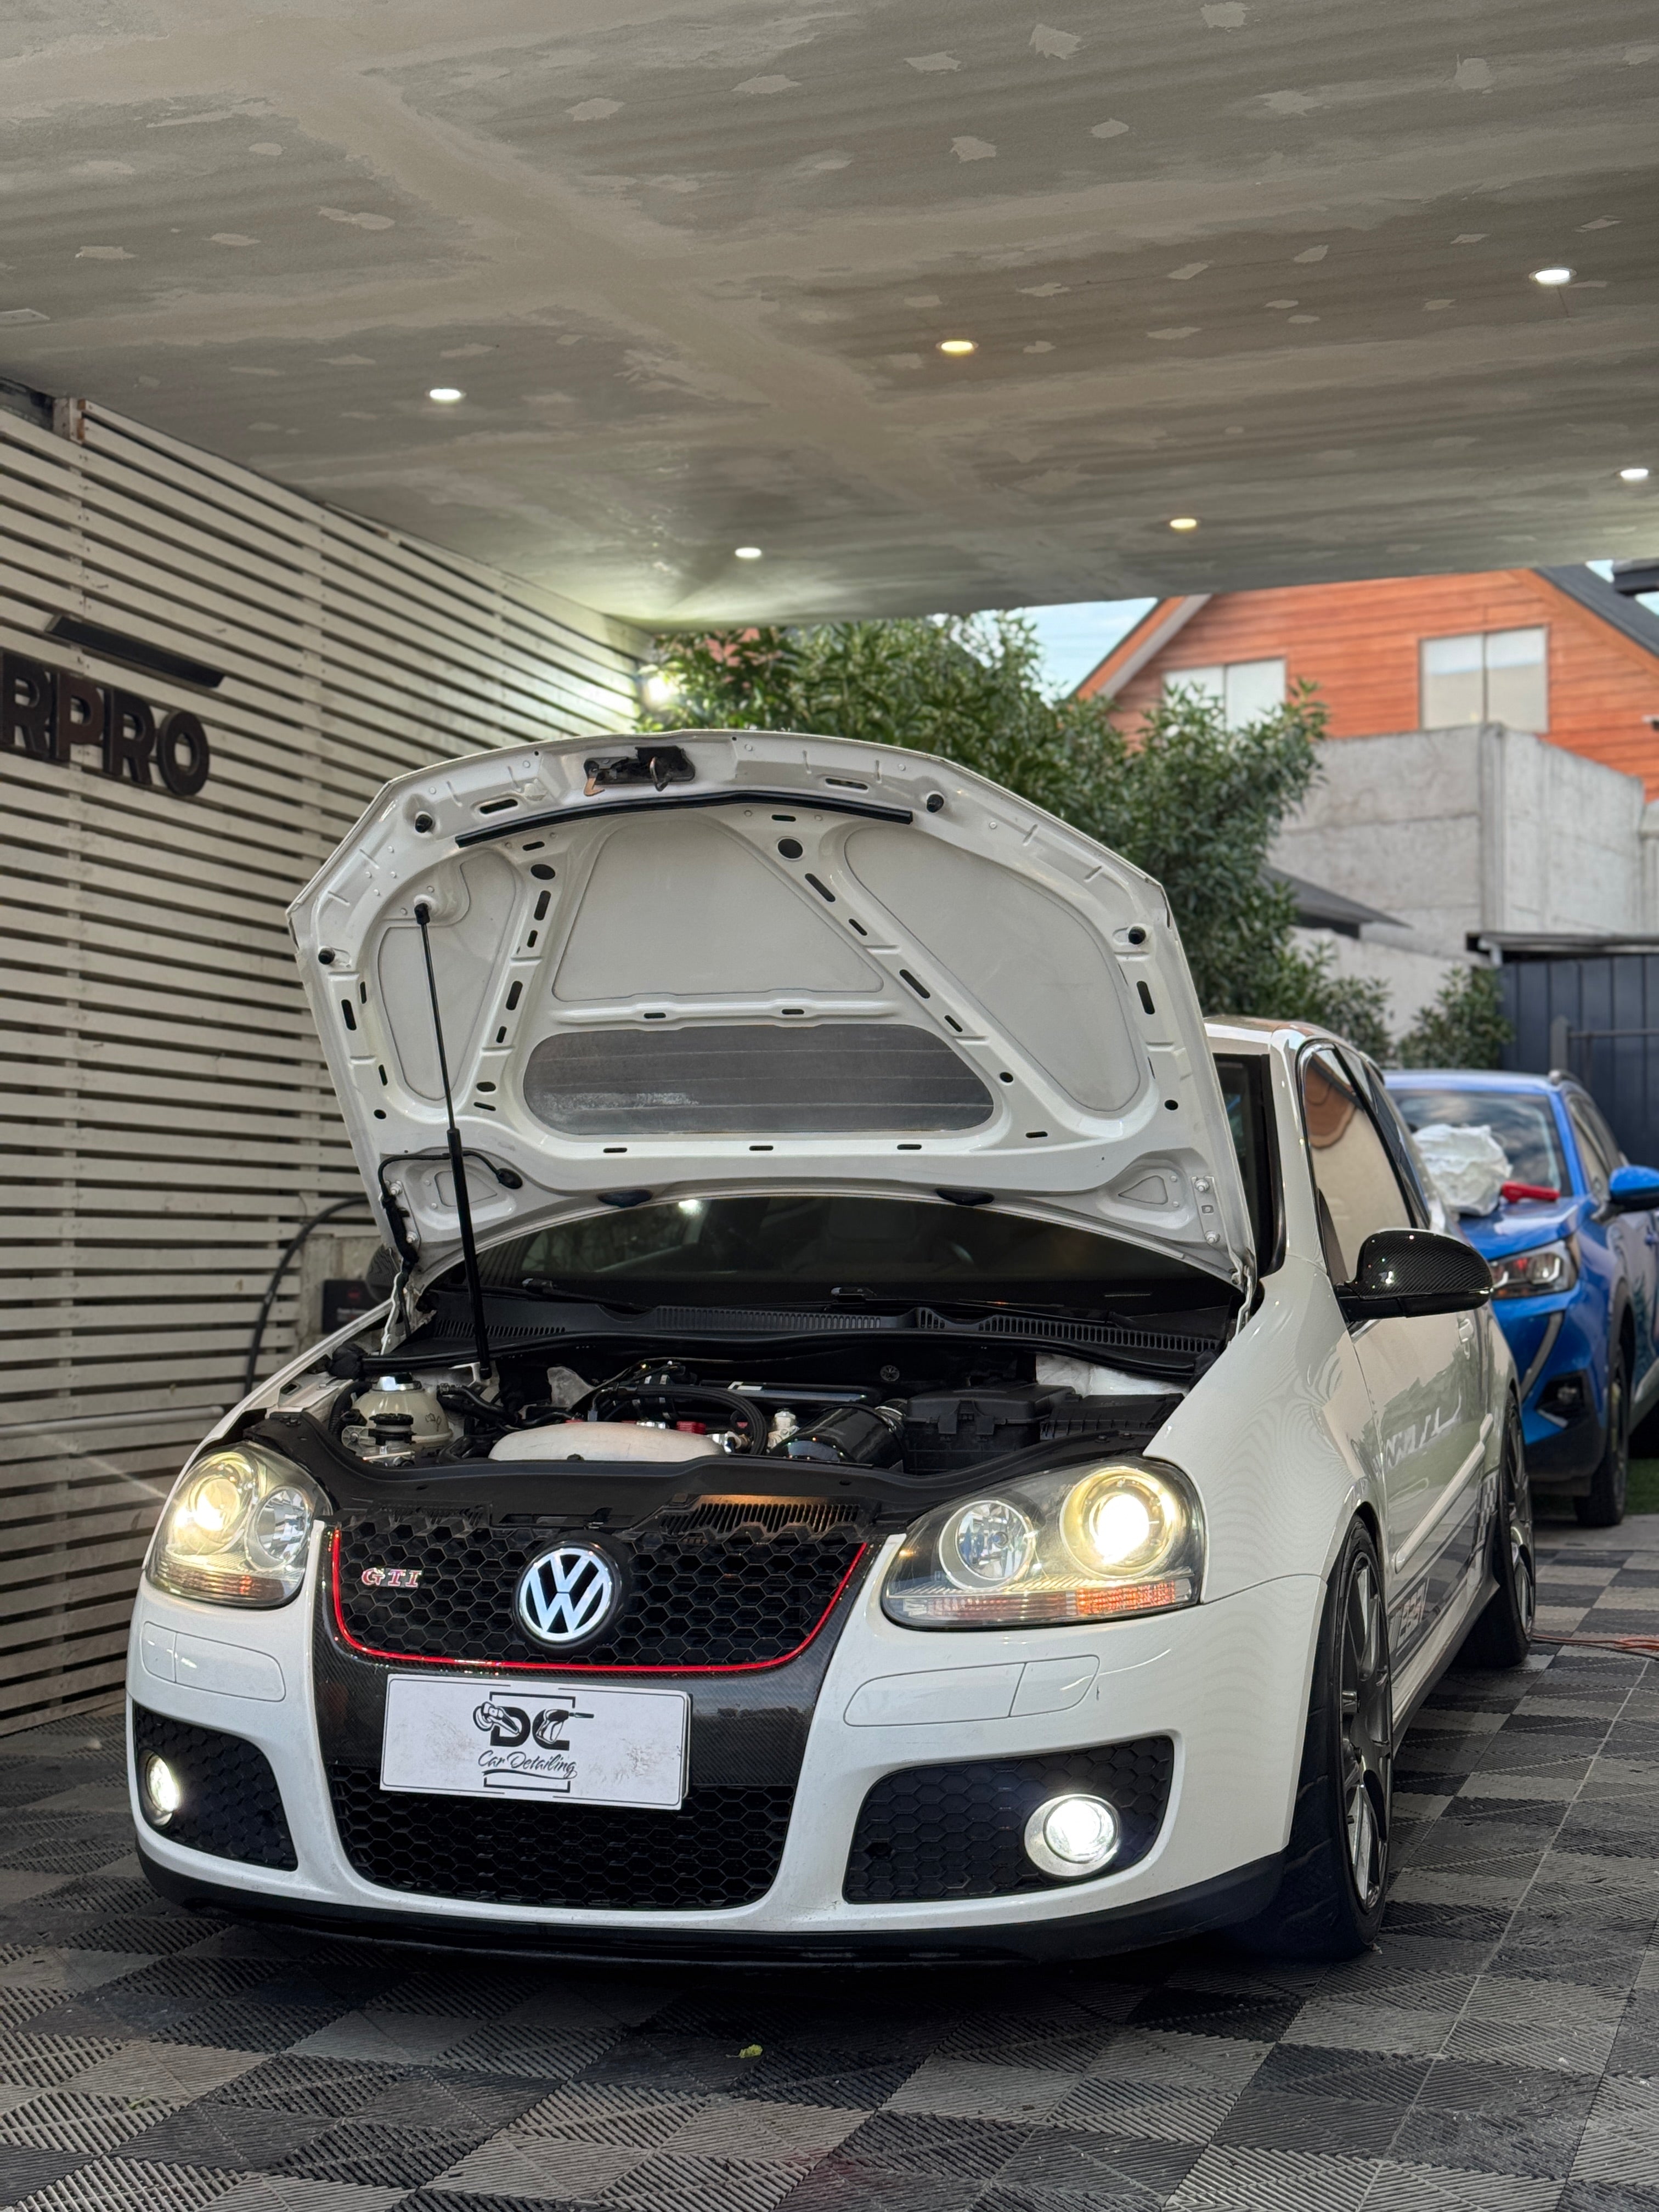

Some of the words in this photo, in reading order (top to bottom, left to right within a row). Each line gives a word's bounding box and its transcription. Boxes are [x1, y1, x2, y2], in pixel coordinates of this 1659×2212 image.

[0, 649, 210, 796] RPRO
[361, 1567, 422, 1588] GTI
[522, 1551, 609, 1638] VW
[478, 1750, 505, 1767] Car
[506, 1751, 578, 1779] Detailing
